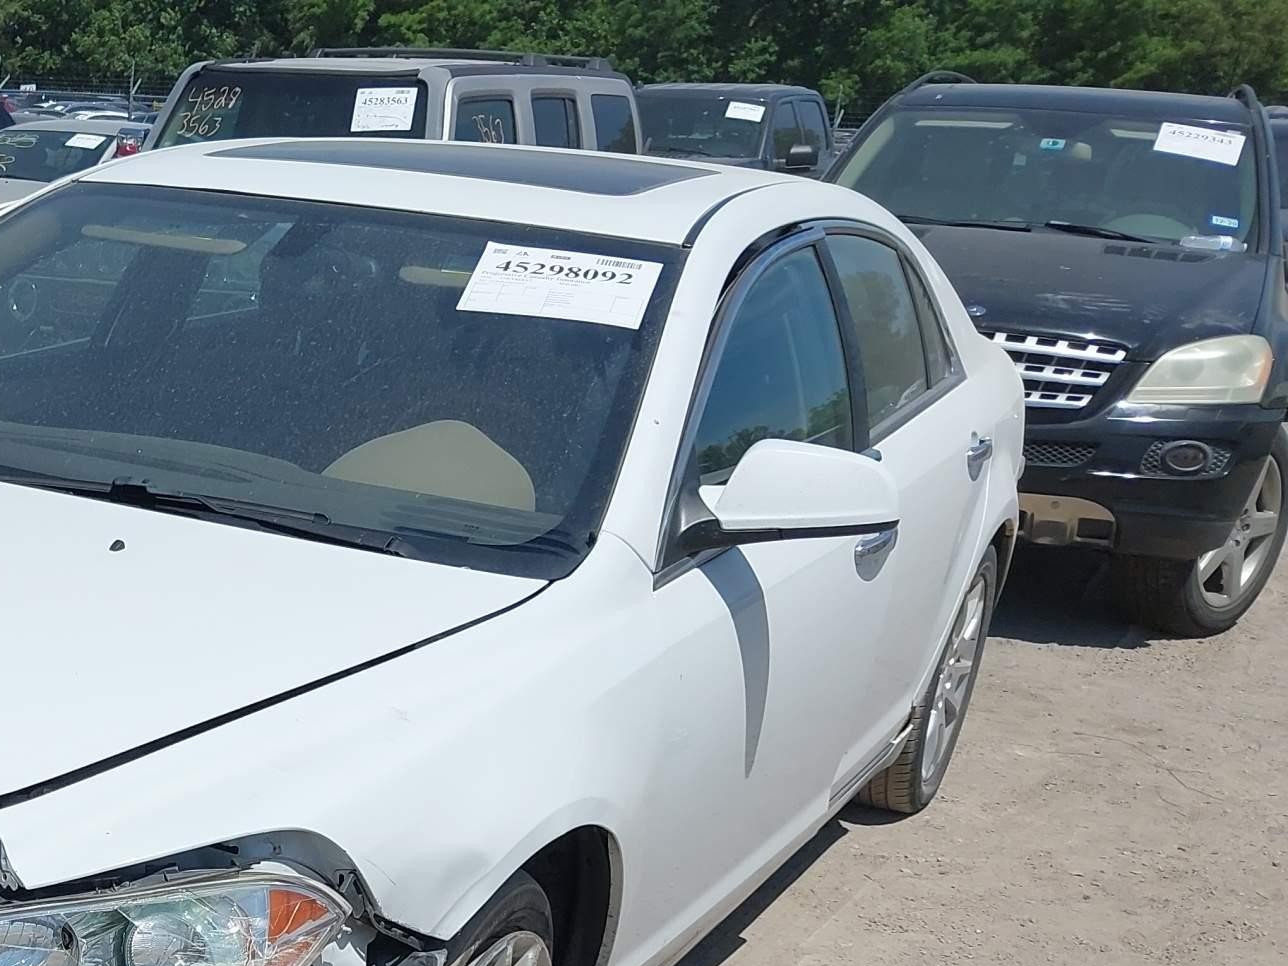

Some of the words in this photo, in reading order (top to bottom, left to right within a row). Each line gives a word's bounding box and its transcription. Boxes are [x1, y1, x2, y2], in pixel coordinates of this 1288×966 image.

[188, 86, 242, 113] 4528
[362, 96, 409, 106] 45283563
[177, 111, 222, 137] 3563
[1169, 129, 1233, 145] 45229343
[496, 260, 634, 285] 45298092
